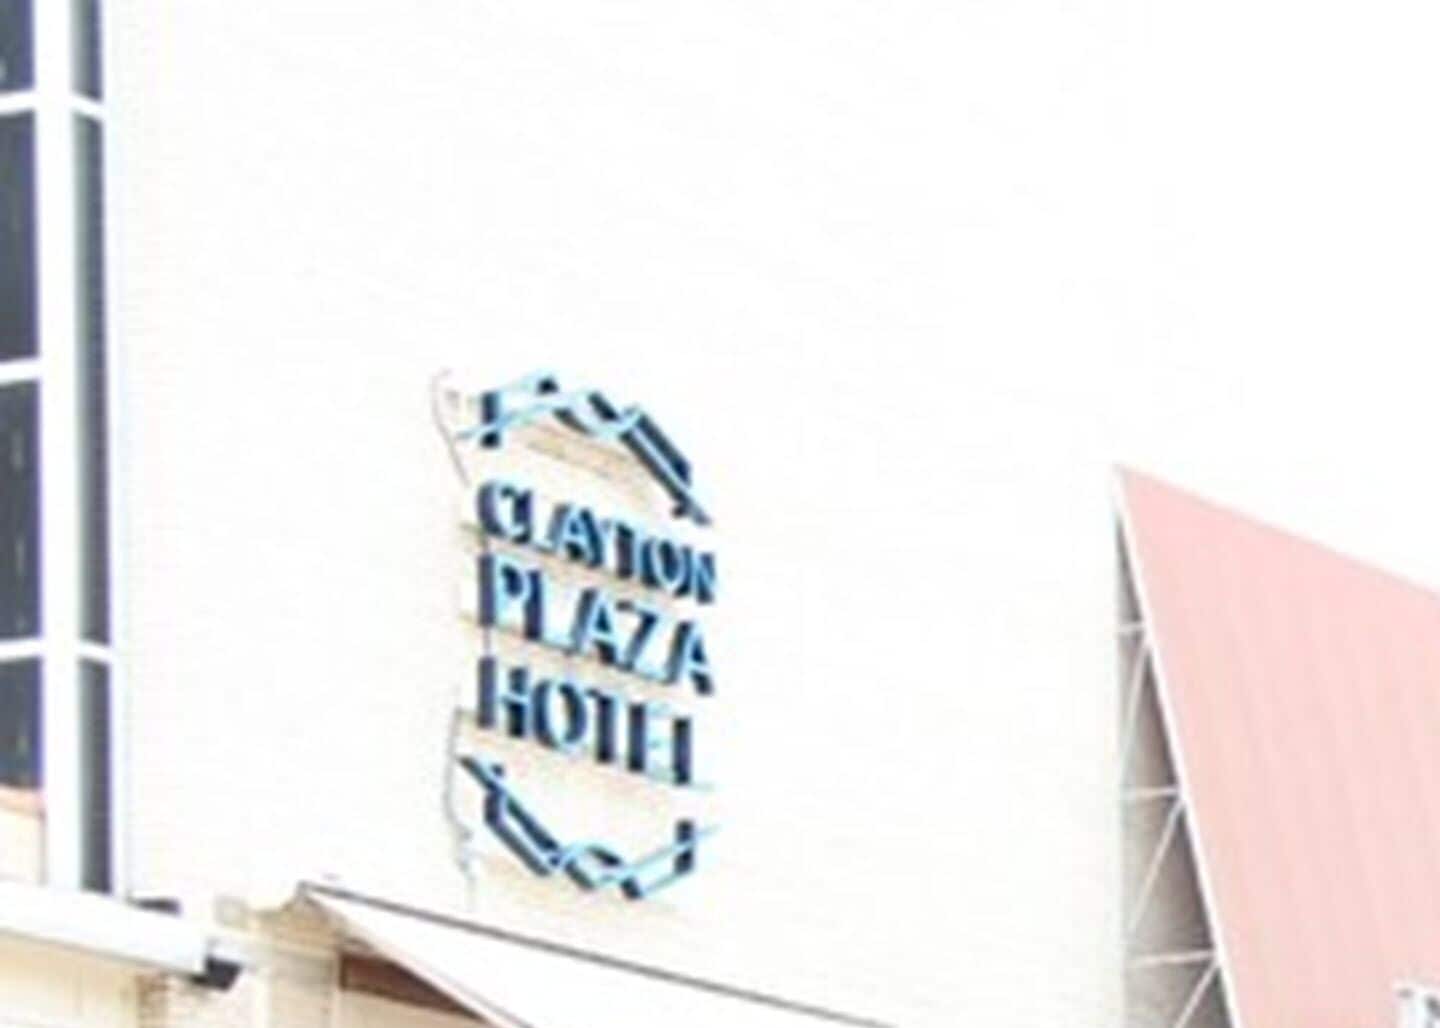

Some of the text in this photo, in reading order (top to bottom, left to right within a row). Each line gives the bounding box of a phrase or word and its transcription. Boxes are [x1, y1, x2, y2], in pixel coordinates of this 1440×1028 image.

[475, 478, 717, 606] CLAYTON
[475, 551, 716, 699] PLAZA
[475, 652, 714, 791] HOTEL
